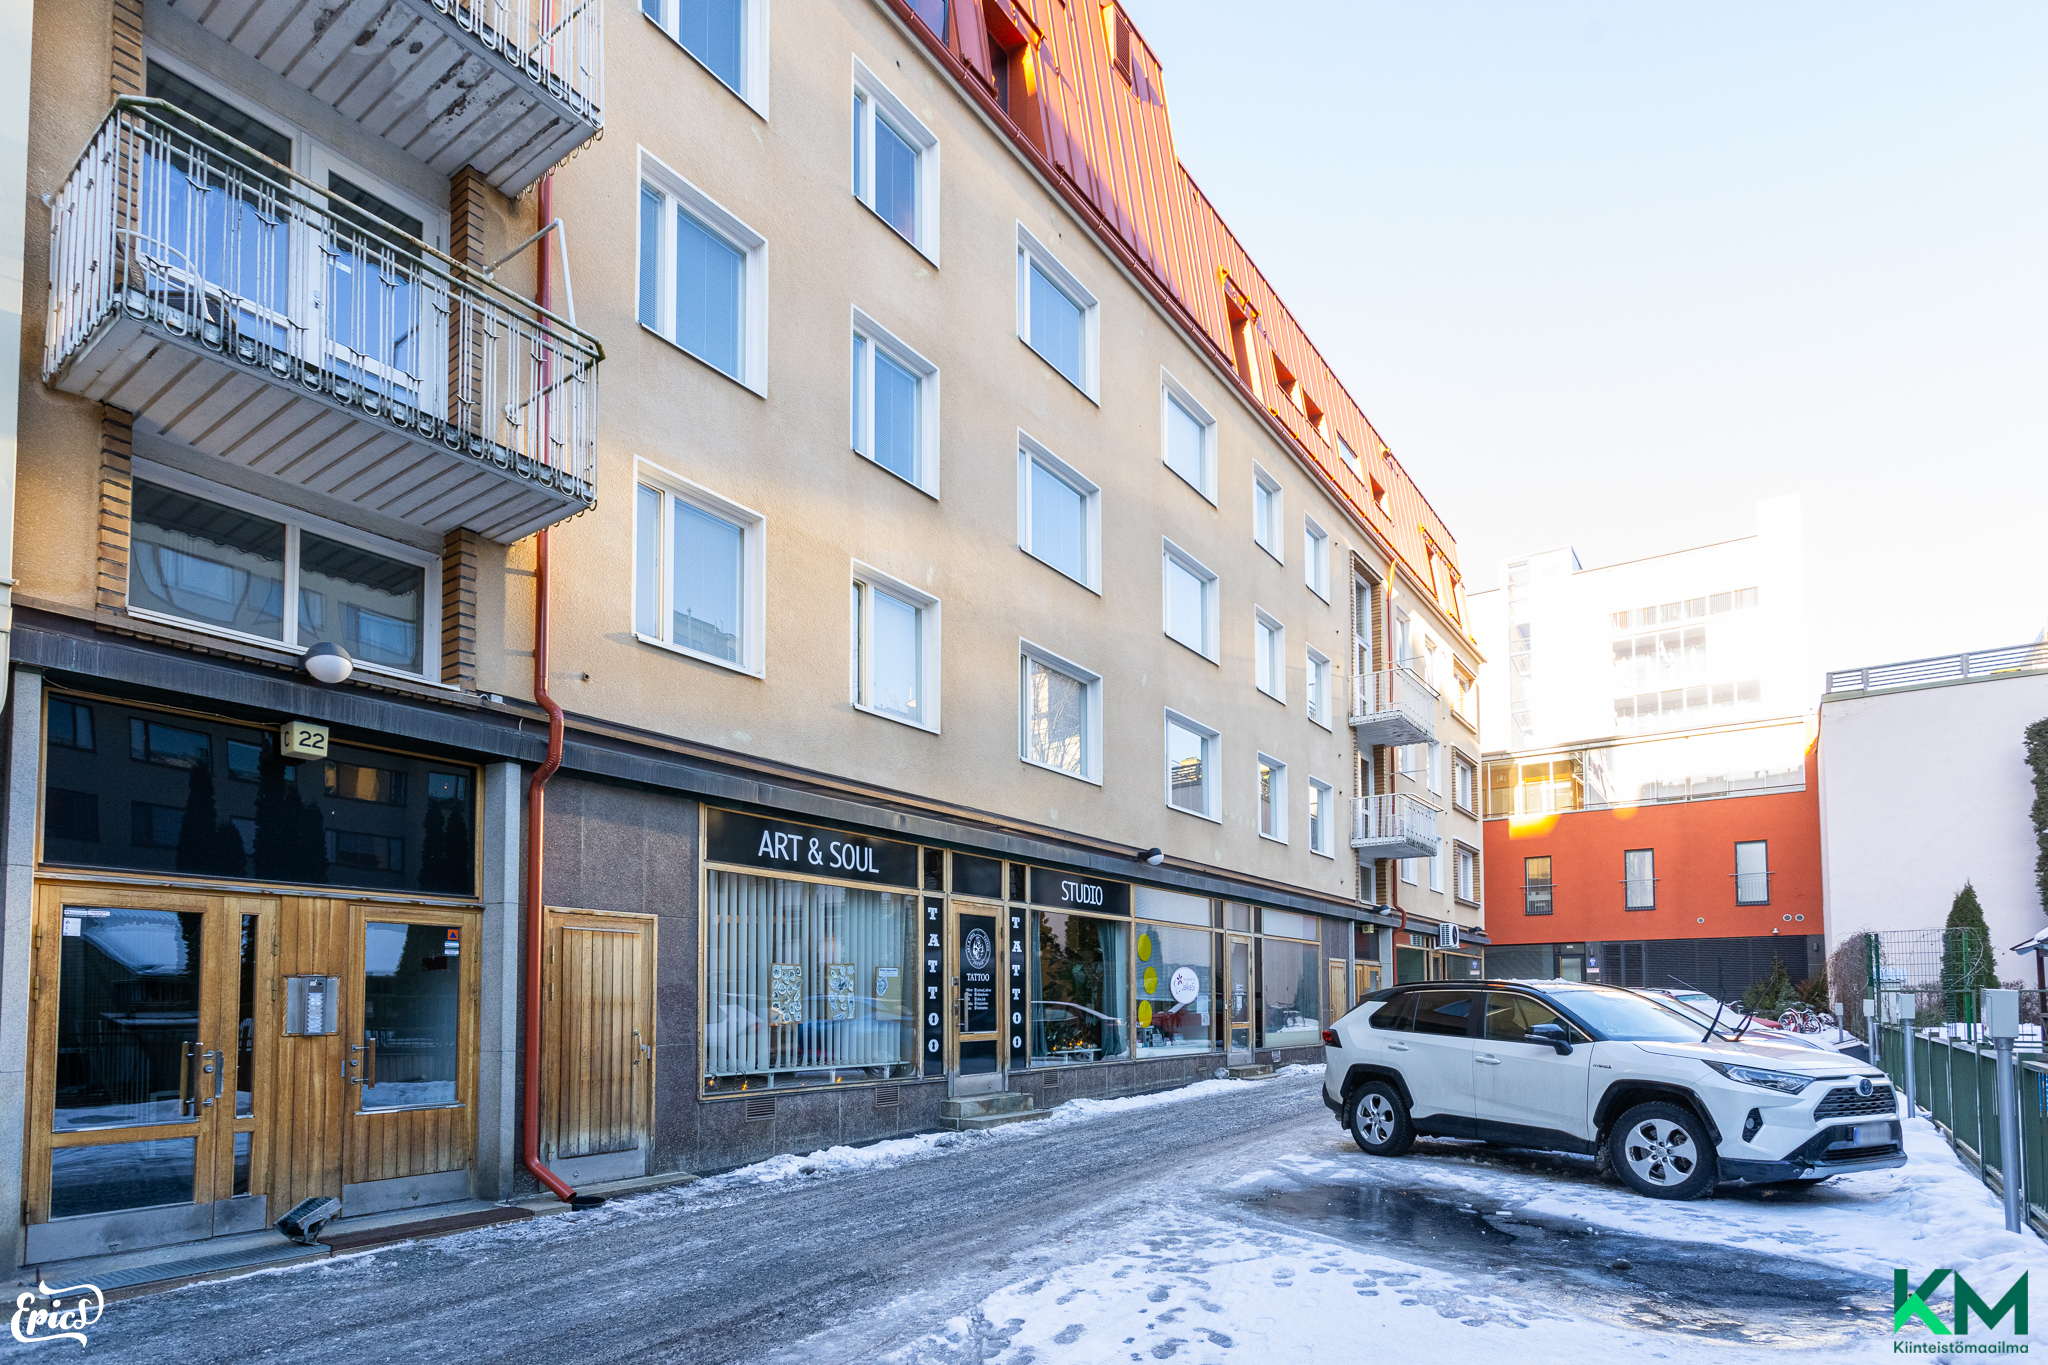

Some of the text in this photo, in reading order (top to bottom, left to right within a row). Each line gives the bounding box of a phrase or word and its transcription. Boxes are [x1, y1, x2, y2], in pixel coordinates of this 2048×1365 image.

[284, 730, 290, 748] C
[299, 730, 325, 750] 22
[758, 829, 880, 874] ART & SOUL
[1061, 880, 1104, 906] STUDIO
[927, 906, 940, 1053] TATTOO
[966, 972, 990, 982] TATTOO
[1011, 916, 1023, 1049] TATTOO
